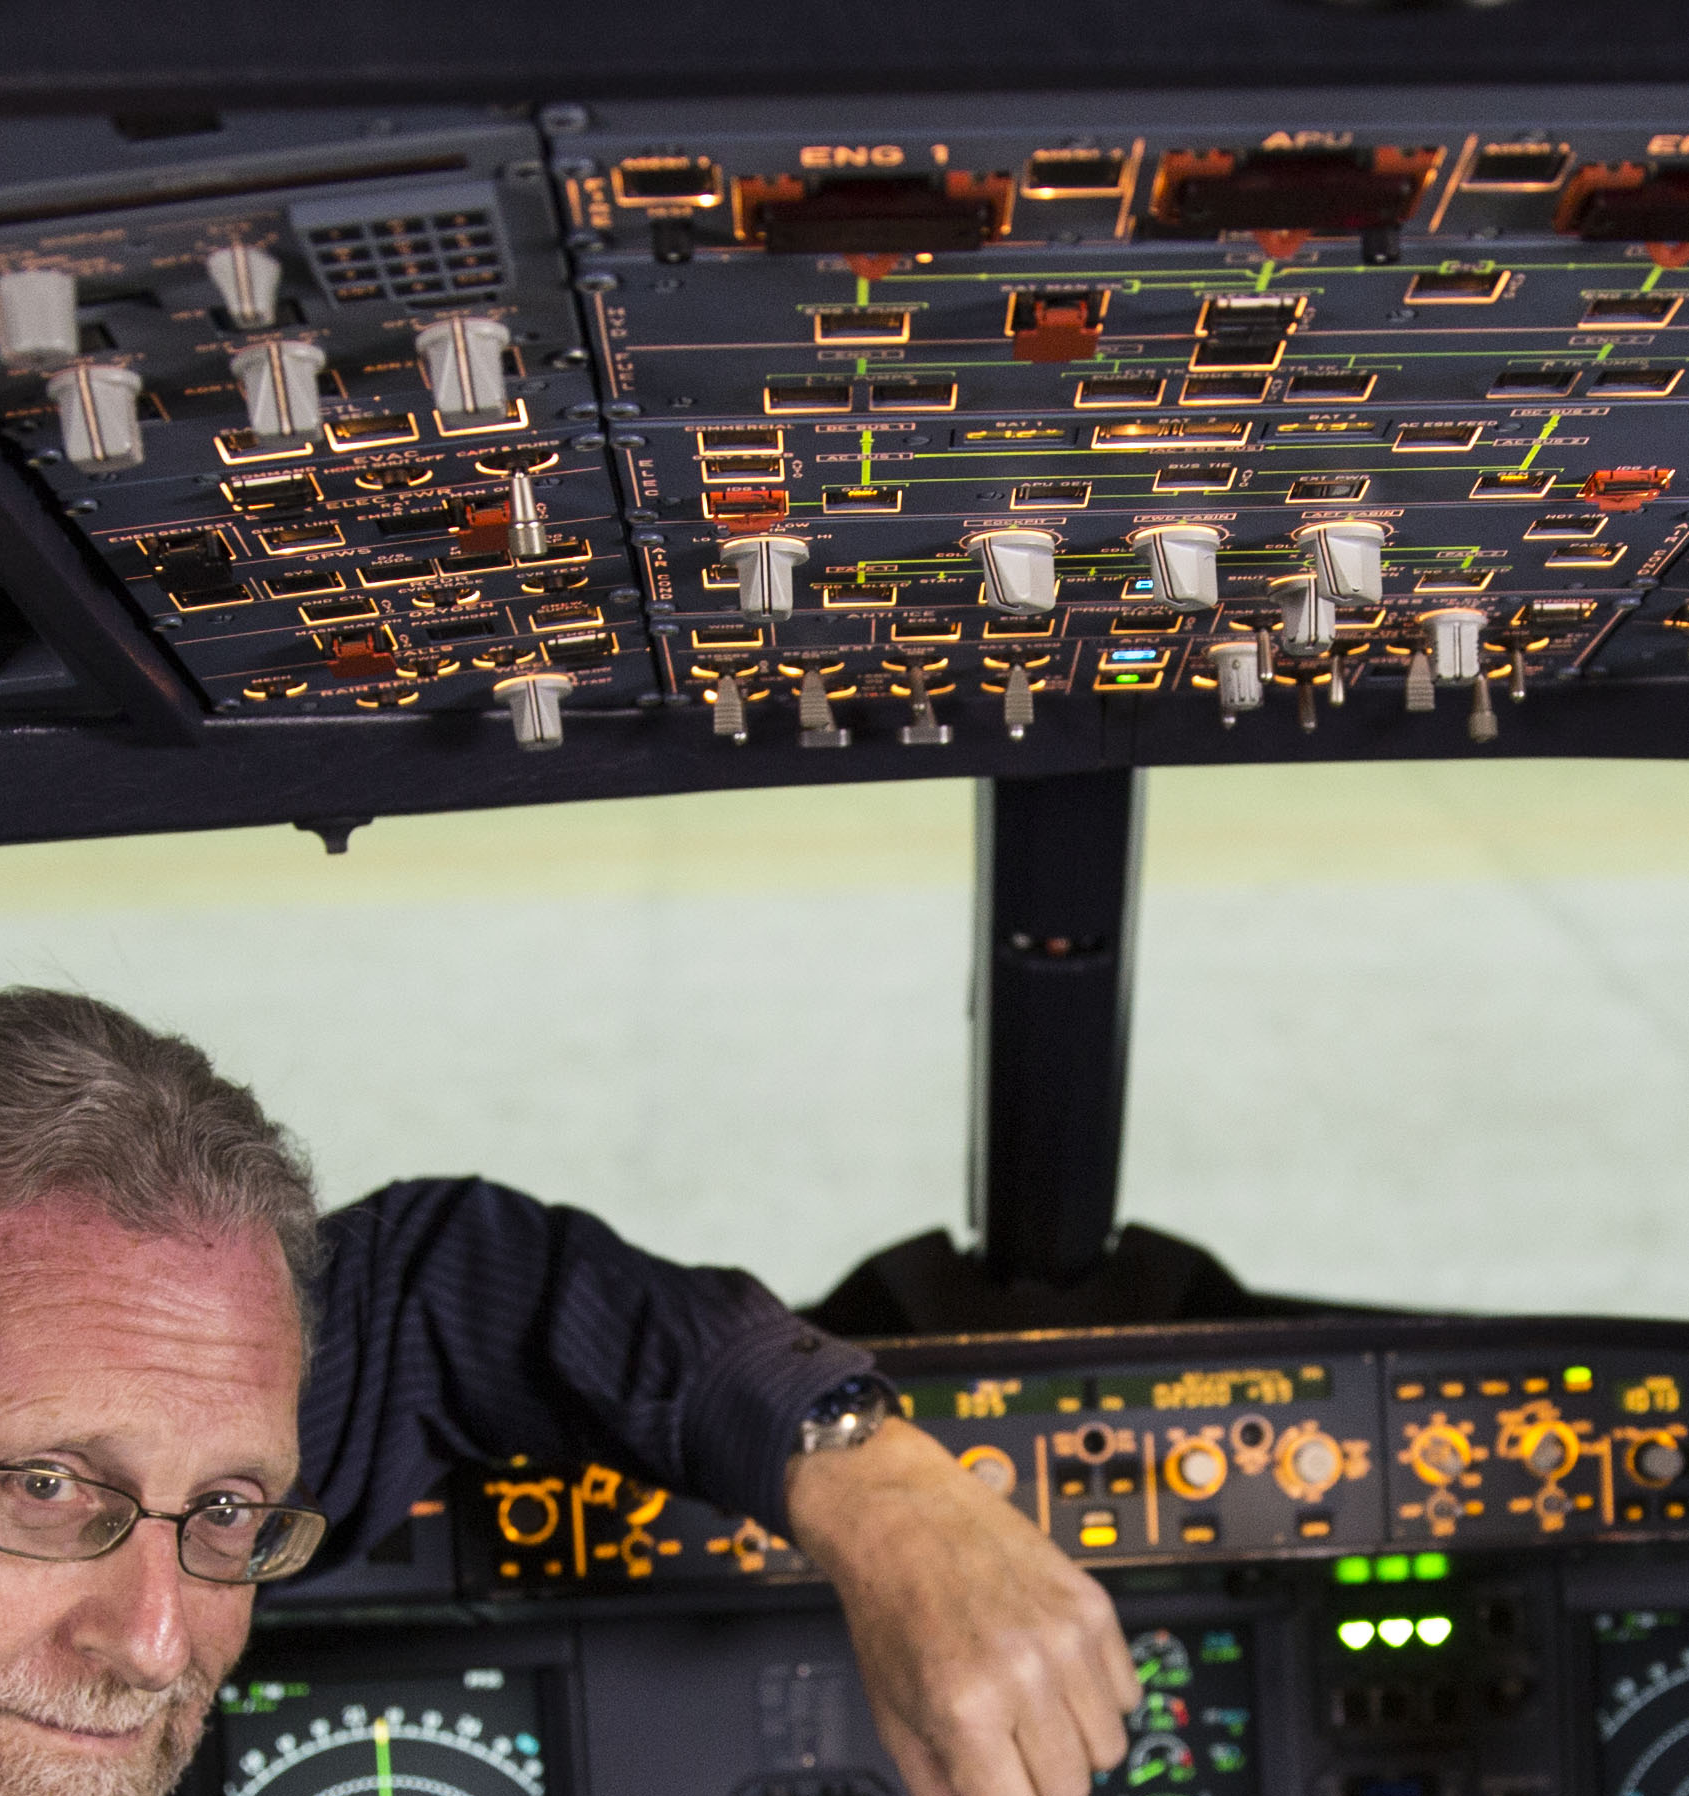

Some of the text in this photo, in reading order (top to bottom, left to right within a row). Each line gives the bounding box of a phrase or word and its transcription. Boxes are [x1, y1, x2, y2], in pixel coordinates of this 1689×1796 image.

[1261, 130, 1354, 152] APU
[799, 143, 950, 169] ENG 1
[684, 423, 795, 432] COMMERCIAL
[1457, 419, 1499, 427] FEED
[455, 440, 561, 457] CAPT & PURS
[323, 453, 447, 474] HORN SHUT OFF
[352, 450, 419, 465] EVAC
[230, 466, 317, 482] COMMAND
[638, 459, 659, 497] ELEC
[325, 487, 452, 510] ELEC PWR
[449, 488, 487, 499] MAN
[380, 500, 411, 509] RAT
[356, 505, 444, 521] EMER GEN
[1140, 513, 1232, 522] FWD CABIN
[1310, 510, 1343, 518] AFT
[250, 525, 285, 535] GEN
[303, 518, 340, 528] LINE
[983, 519, 1047, 527] COCKPIT
[107, 520, 235, 543] EMER GEN TEST
[1569, 541, 1610, 549] PACK
[304, 547, 373, 562] GPWS
[371, 556, 414, 566] MODE
[1636, 549, 1668, 576] COND
[283, 569, 314, 577] SYS
[515, 565, 588, 579] CVR TEST
[397, 577, 486, 594] CVR ERASE
[408, 574, 470, 588] RCDR
[656, 573, 674, 600] COND
[301, 594, 367, 606] GND CTL
[540, 599, 584, 610] CREW
[408, 601, 495, 618] OXYGEN
[536, 603, 591, 615] SUPPLY
[846, 610, 936, 619] ANTI ICE
[410, 610, 500, 627] PASSENGER
[294, 617, 404, 636] MASK MAN ON
[1119, 637, 1161, 645] APU
[488, 644, 515, 653] AFT
[408, 653, 442, 663] FWD
[250, 674, 293, 684] MECH
[320, 675, 440, 697] RAIN RPLNT
